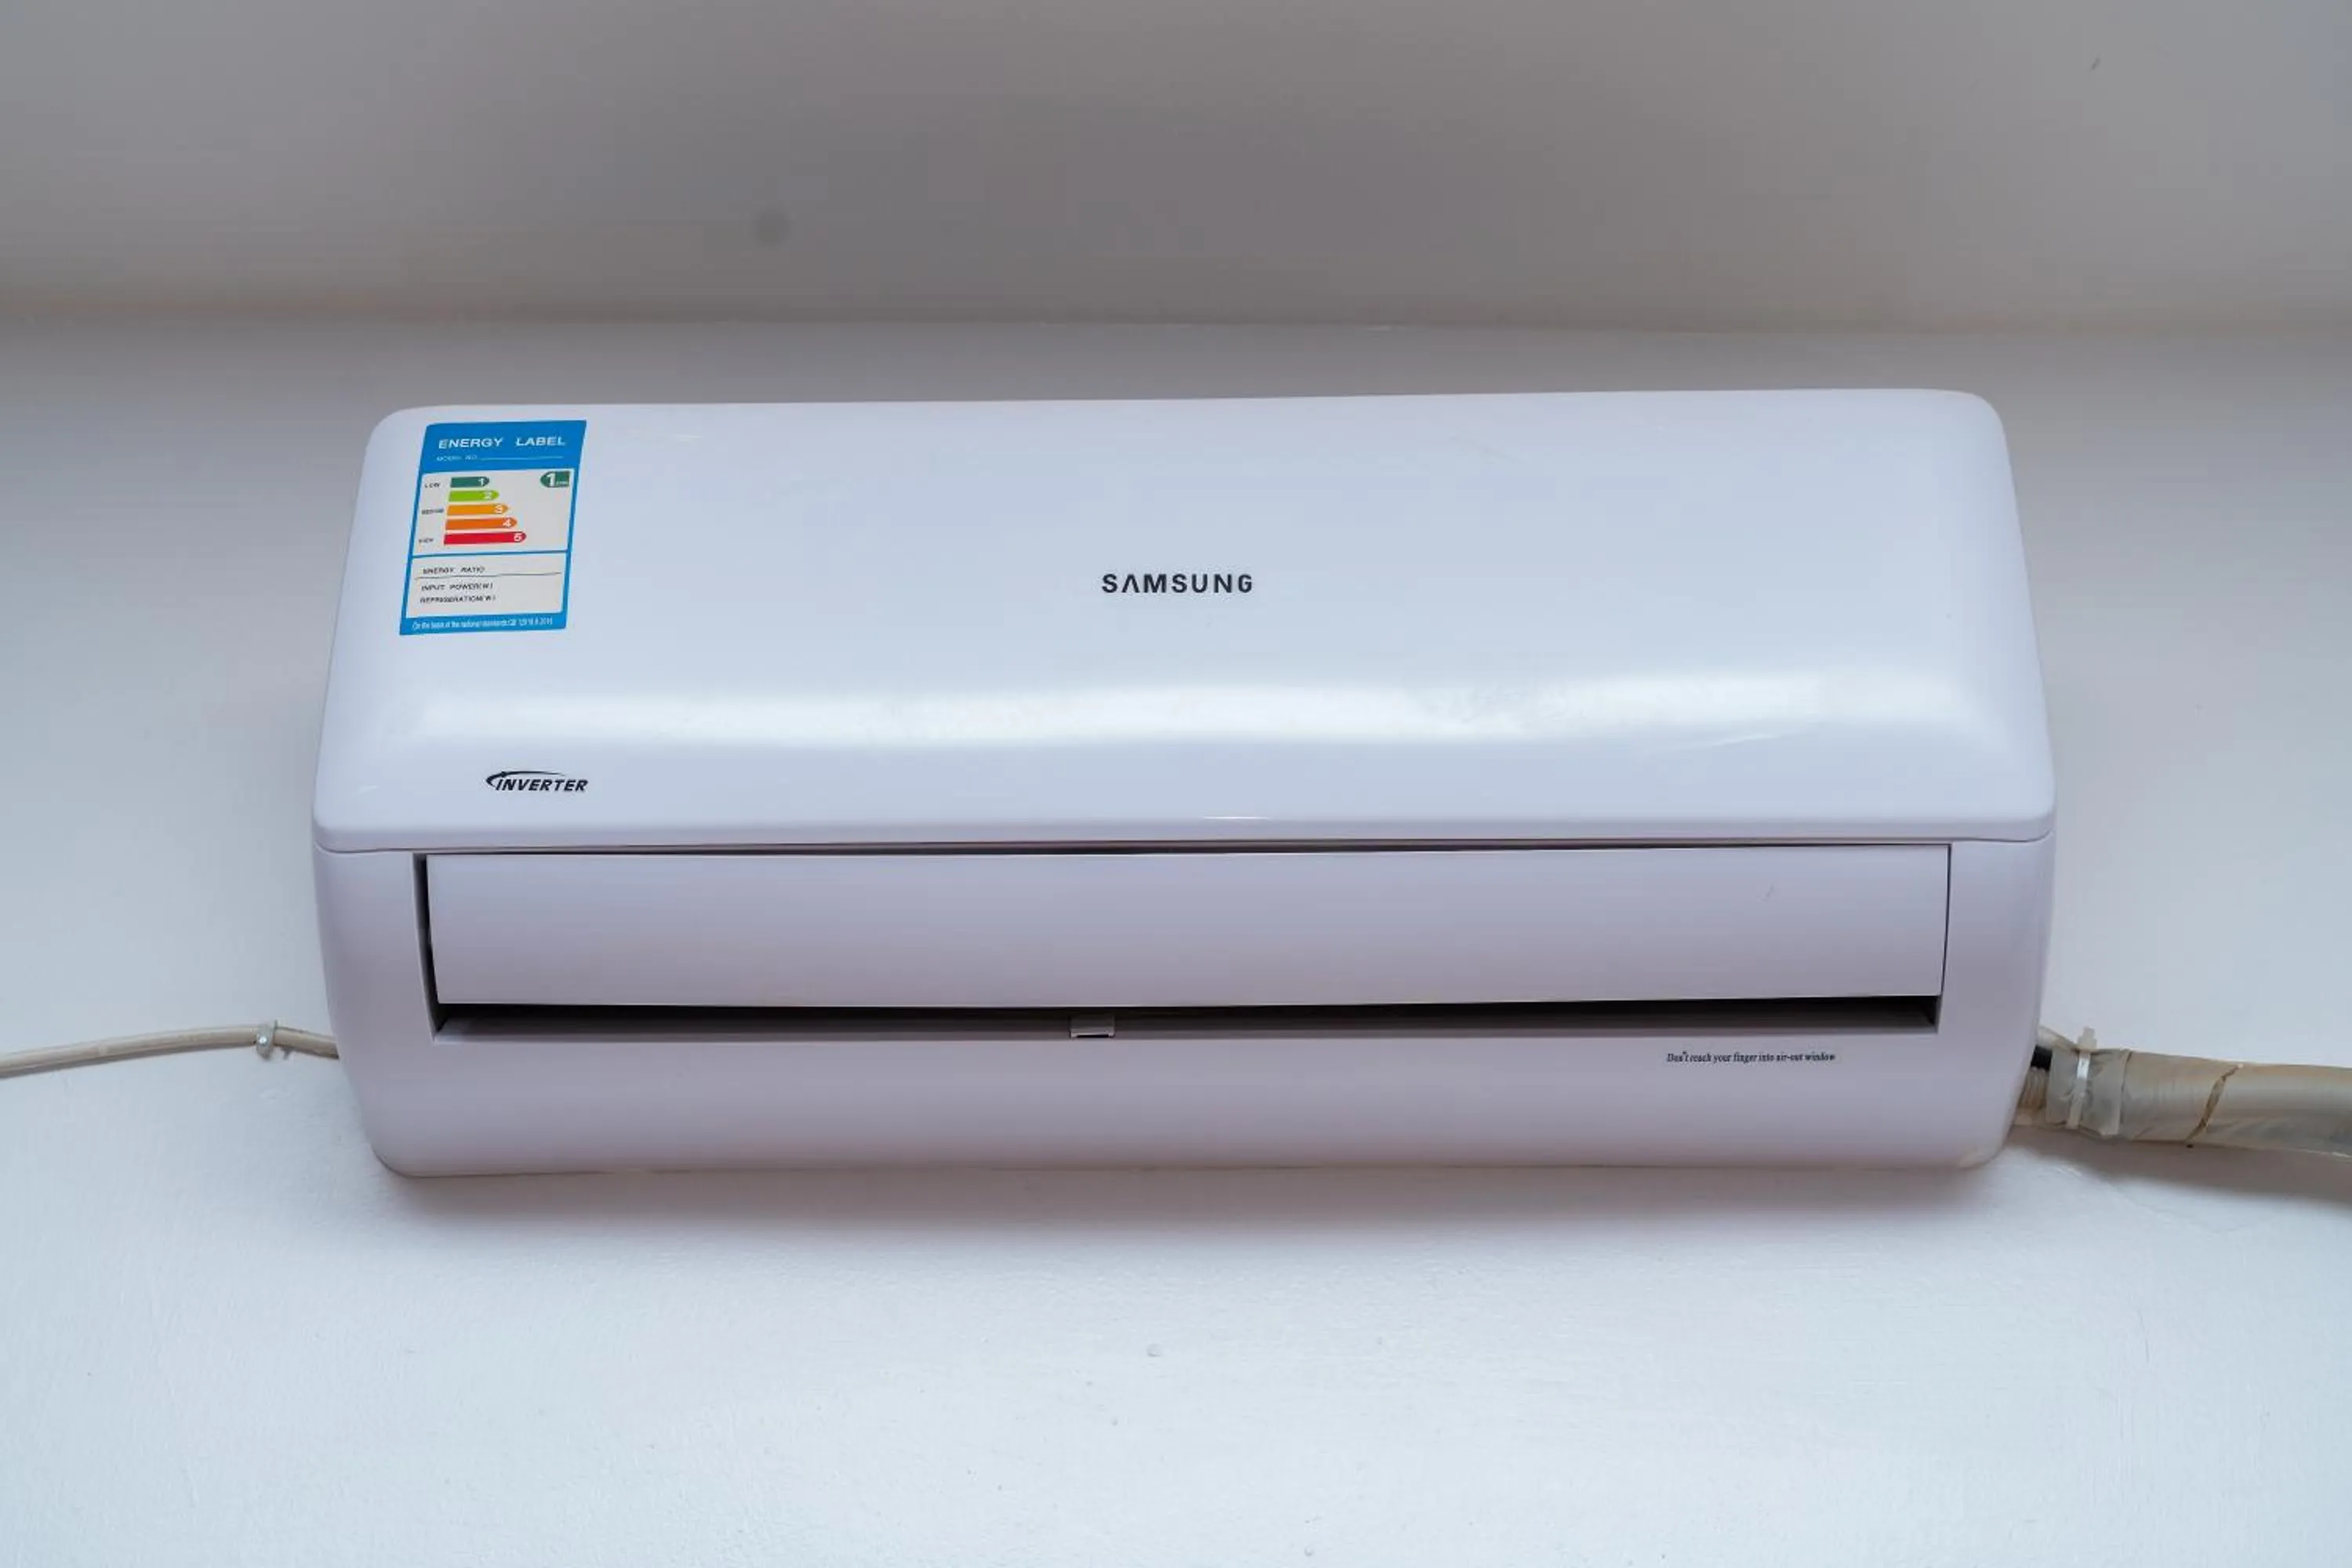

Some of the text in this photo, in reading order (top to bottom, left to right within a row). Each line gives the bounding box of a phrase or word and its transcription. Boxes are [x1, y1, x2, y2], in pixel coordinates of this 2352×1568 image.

[438, 435, 566, 449] ENERGY LABEL
[478, 477, 485, 486] 1
[547, 472, 555, 486] 1
[495, 504, 503, 514] 3
[503, 518, 512, 527] 4
[1102, 574, 1252, 593] SAMSUNG
[495, 778, 588, 791] INVERTER
[1667, 1051, 1835, 1064] Don't reach your finger into air-out window
